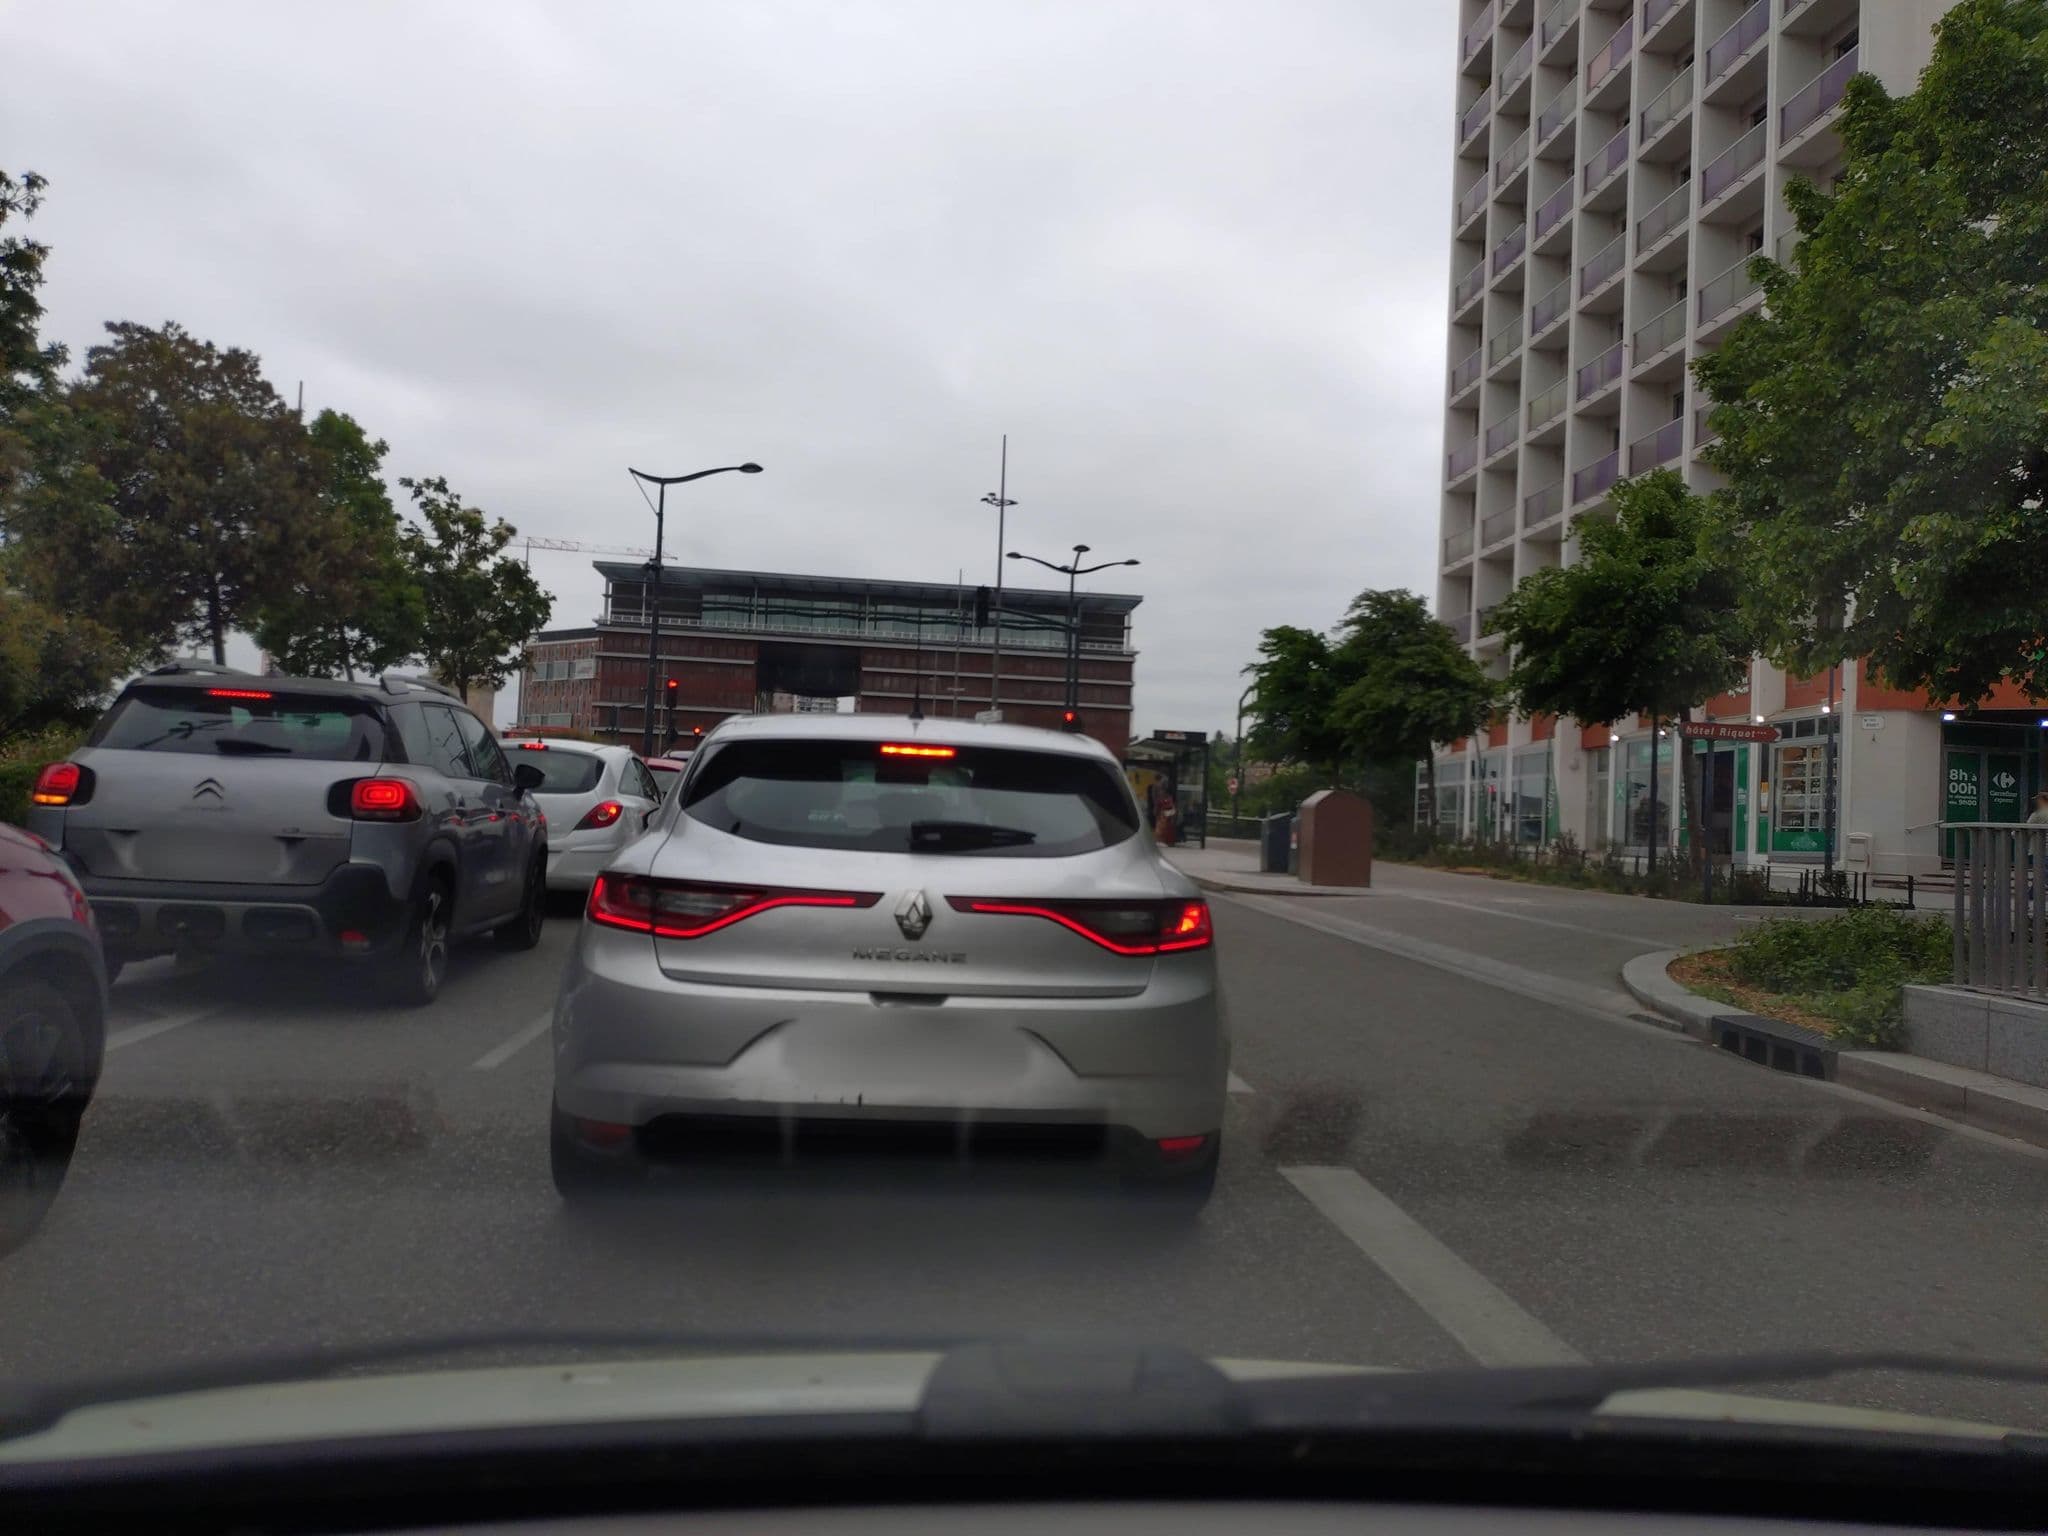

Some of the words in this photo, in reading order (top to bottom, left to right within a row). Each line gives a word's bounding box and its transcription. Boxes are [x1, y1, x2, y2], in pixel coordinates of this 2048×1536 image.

[1949, 768, 1968, 781] 8h
[1949, 782, 1977, 795] 00h
[853, 948, 968, 964] MEGANE
